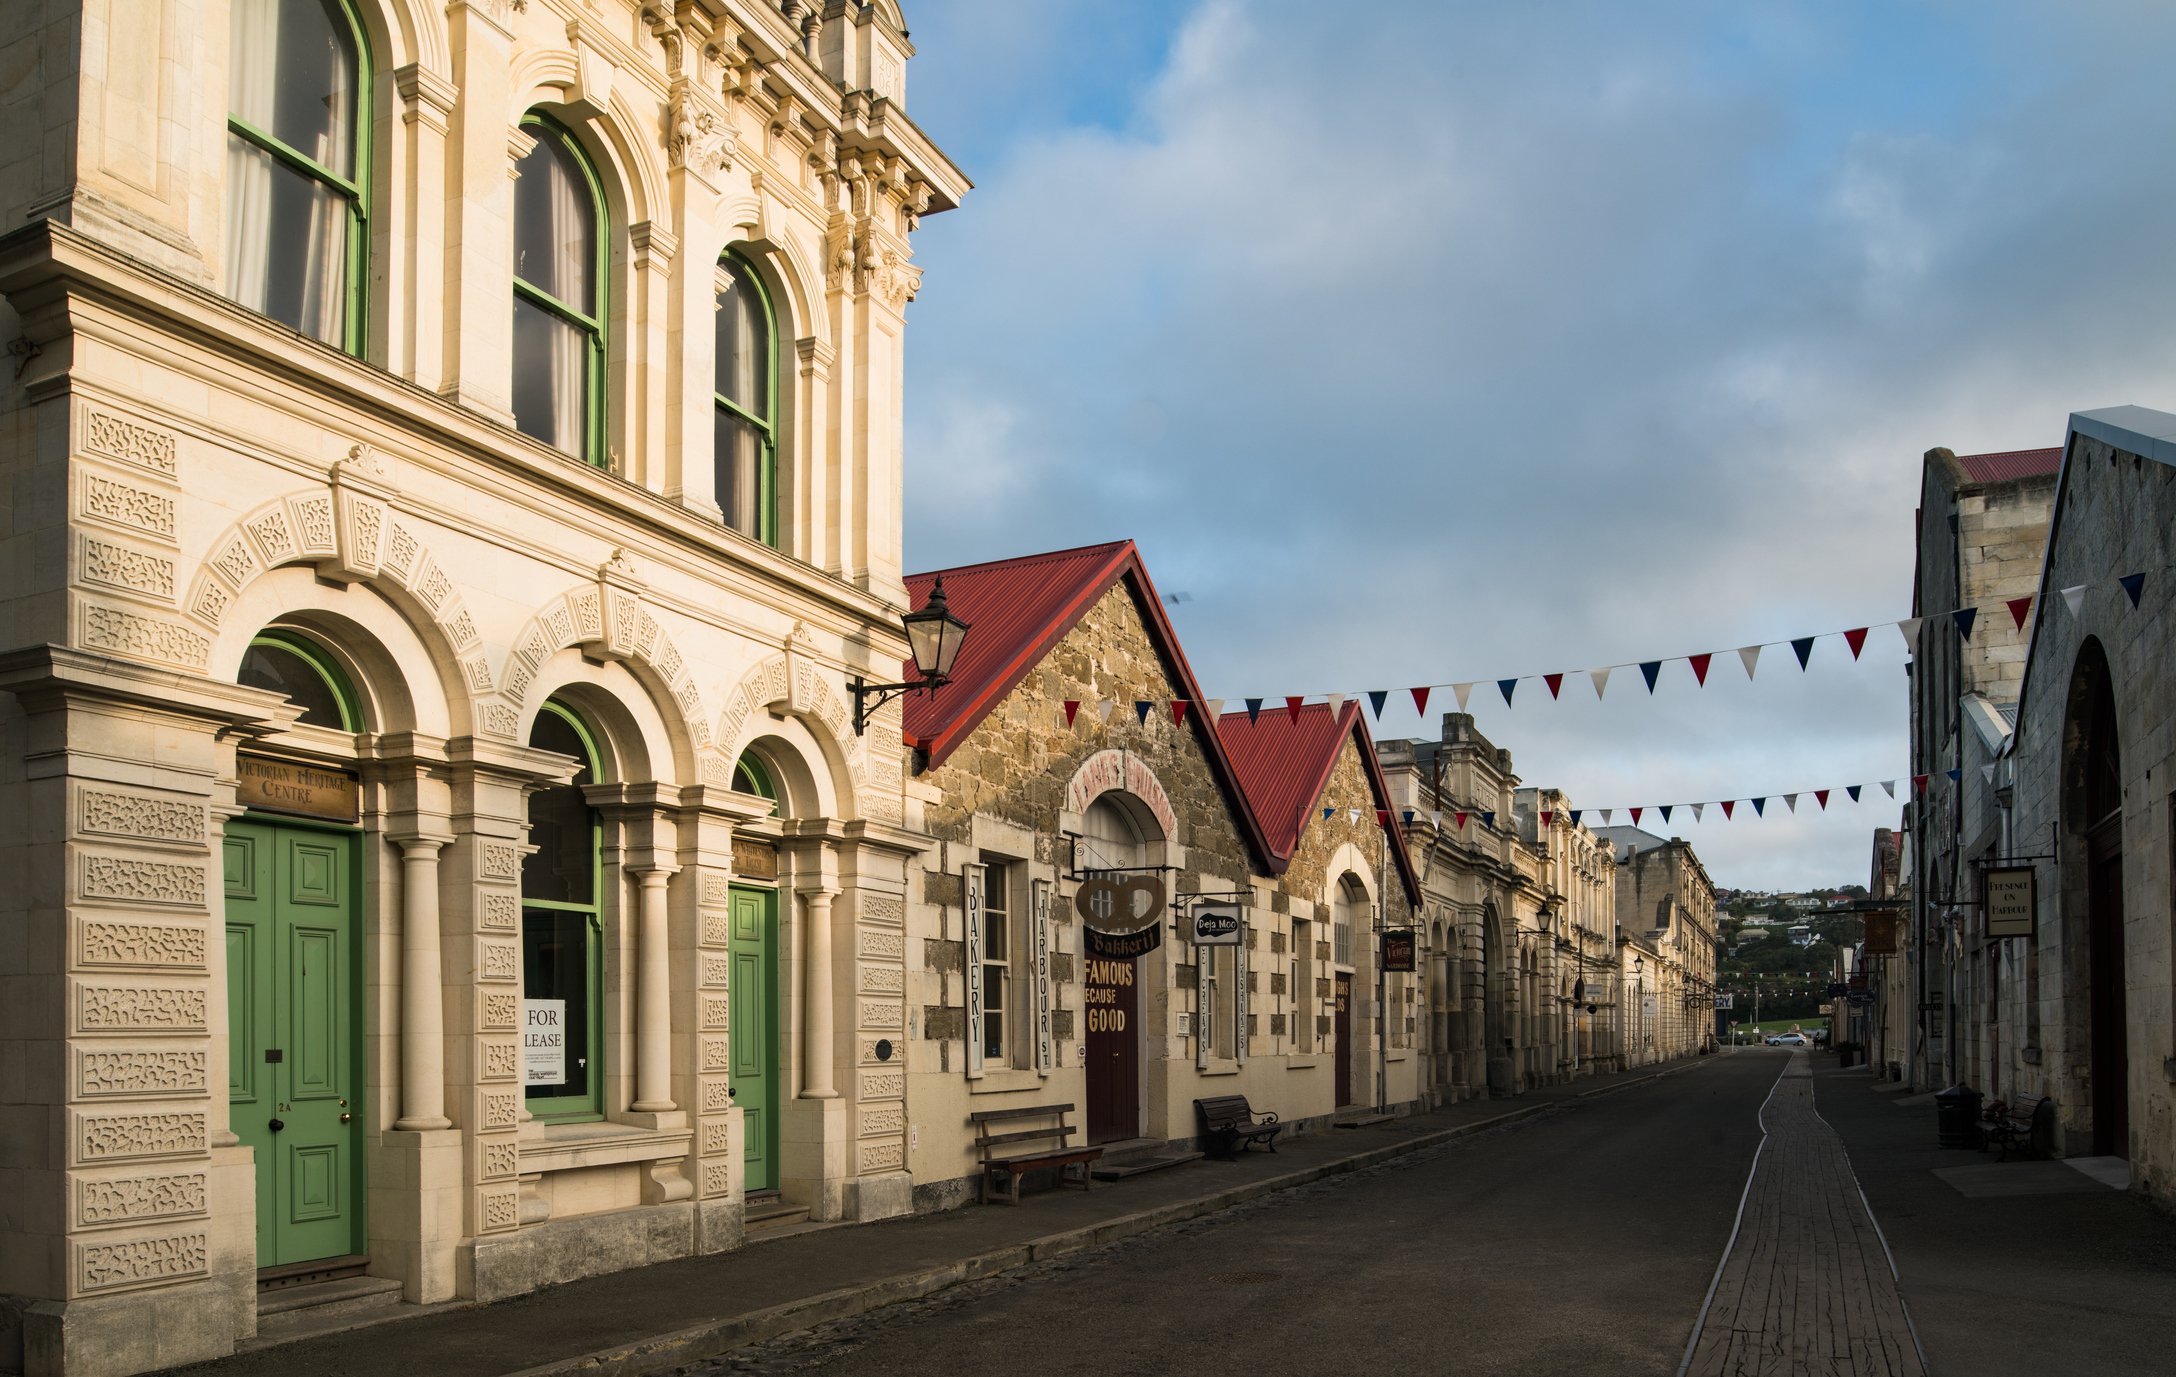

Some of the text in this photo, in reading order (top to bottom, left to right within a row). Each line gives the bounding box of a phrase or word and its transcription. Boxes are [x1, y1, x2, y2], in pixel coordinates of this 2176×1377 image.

[237, 759, 347, 792] VICTORIAN HERITAGE
[262, 780, 312, 804] CENTRE
[1989, 882, 2028, 891] PRESENCE
[2004, 893, 2016, 901] ON
[1992, 905, 2028, 915] HARBOUR
[1198, 919, 1236, 933] Deja Moo
[1090, 928, 1155, 956] Bakkerij
[969, 886, 979, 1042] BAKERY
[1038, 898, 1048, 1033] HARBOUR
[1084, 959, 1133, 986] FAMOUS
[1085, 987, 1116, 1004] ECAUSE
[1337, 981, 1349, 996] GHS
[527, 1009, 558, 1026] FOR
[1088, 1008, 1125, 1033] GOOD
[524, 1033, 562, 1047] LEASE
[278, 1102, 292, 1112] 2A
